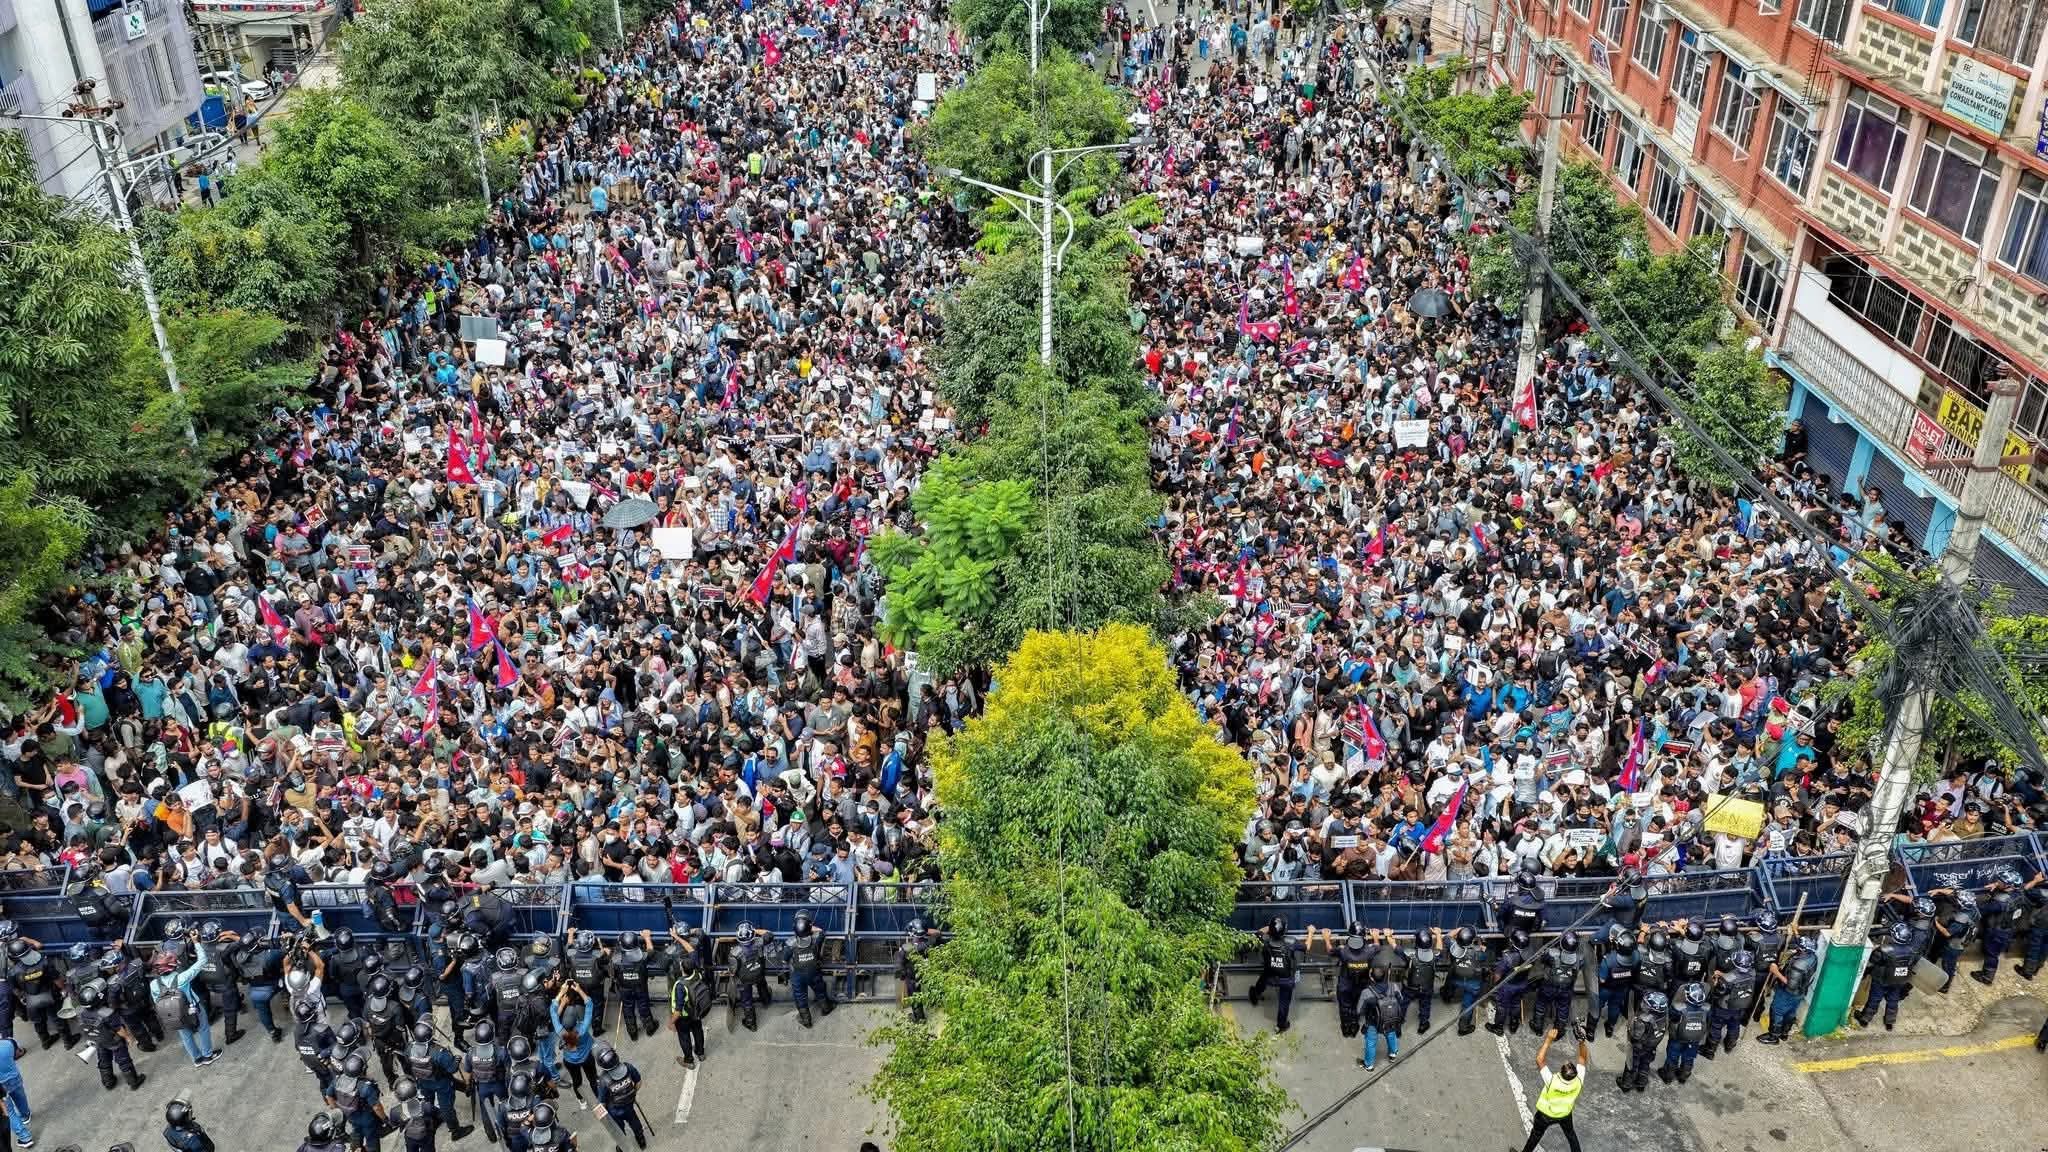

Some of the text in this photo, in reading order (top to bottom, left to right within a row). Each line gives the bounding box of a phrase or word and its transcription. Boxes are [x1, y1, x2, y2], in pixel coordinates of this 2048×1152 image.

[1950, 91, 1988, 113] CONSULTANCY
[1952, 81, 1974, 96] EURASIA
[1975, 91, 2007, 111] EDUCATION
[1914, 416, 1942, 446] TO-LET
[1943, 415, 1979, 449] TRAINING
